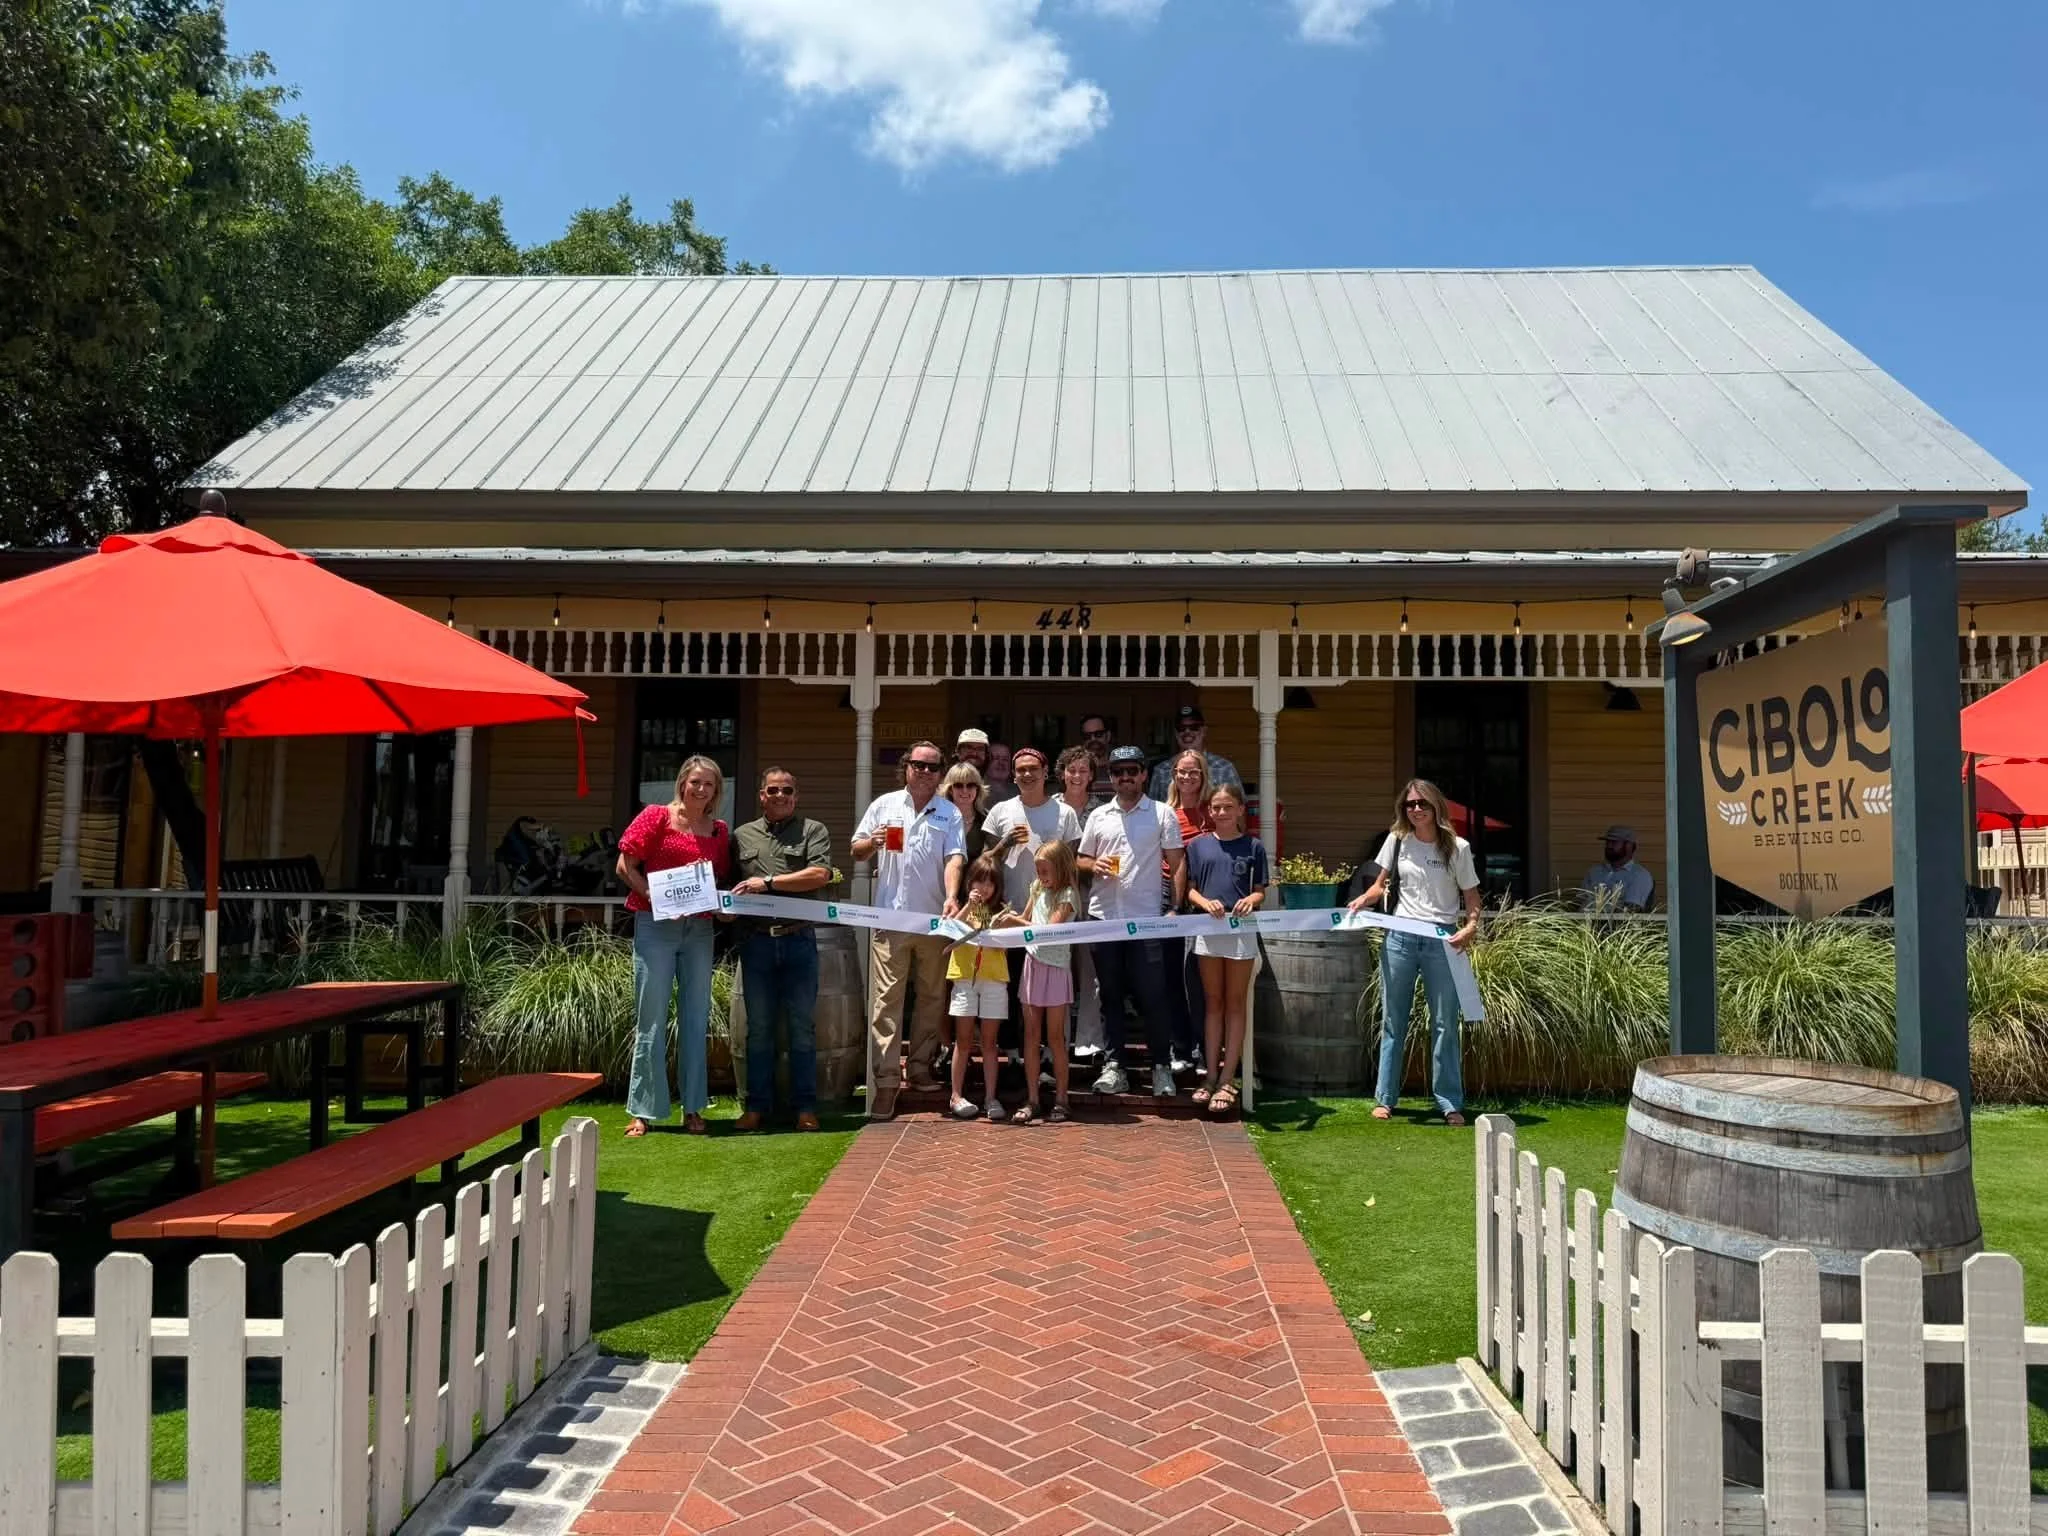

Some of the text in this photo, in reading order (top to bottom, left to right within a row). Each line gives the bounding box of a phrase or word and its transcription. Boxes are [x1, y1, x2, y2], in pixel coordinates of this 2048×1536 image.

[1036, 607, 1091, 630] 448
[1709, 667, 1891, 793] CIBOLO
[1751, 777, 1860, 827] CREEK
[1754, 828, 1864, 847] BREWING CO.
[664, 884, 702, 899] CIBOLO
[1779, 872, 1838, 895] BOERNE, TX
